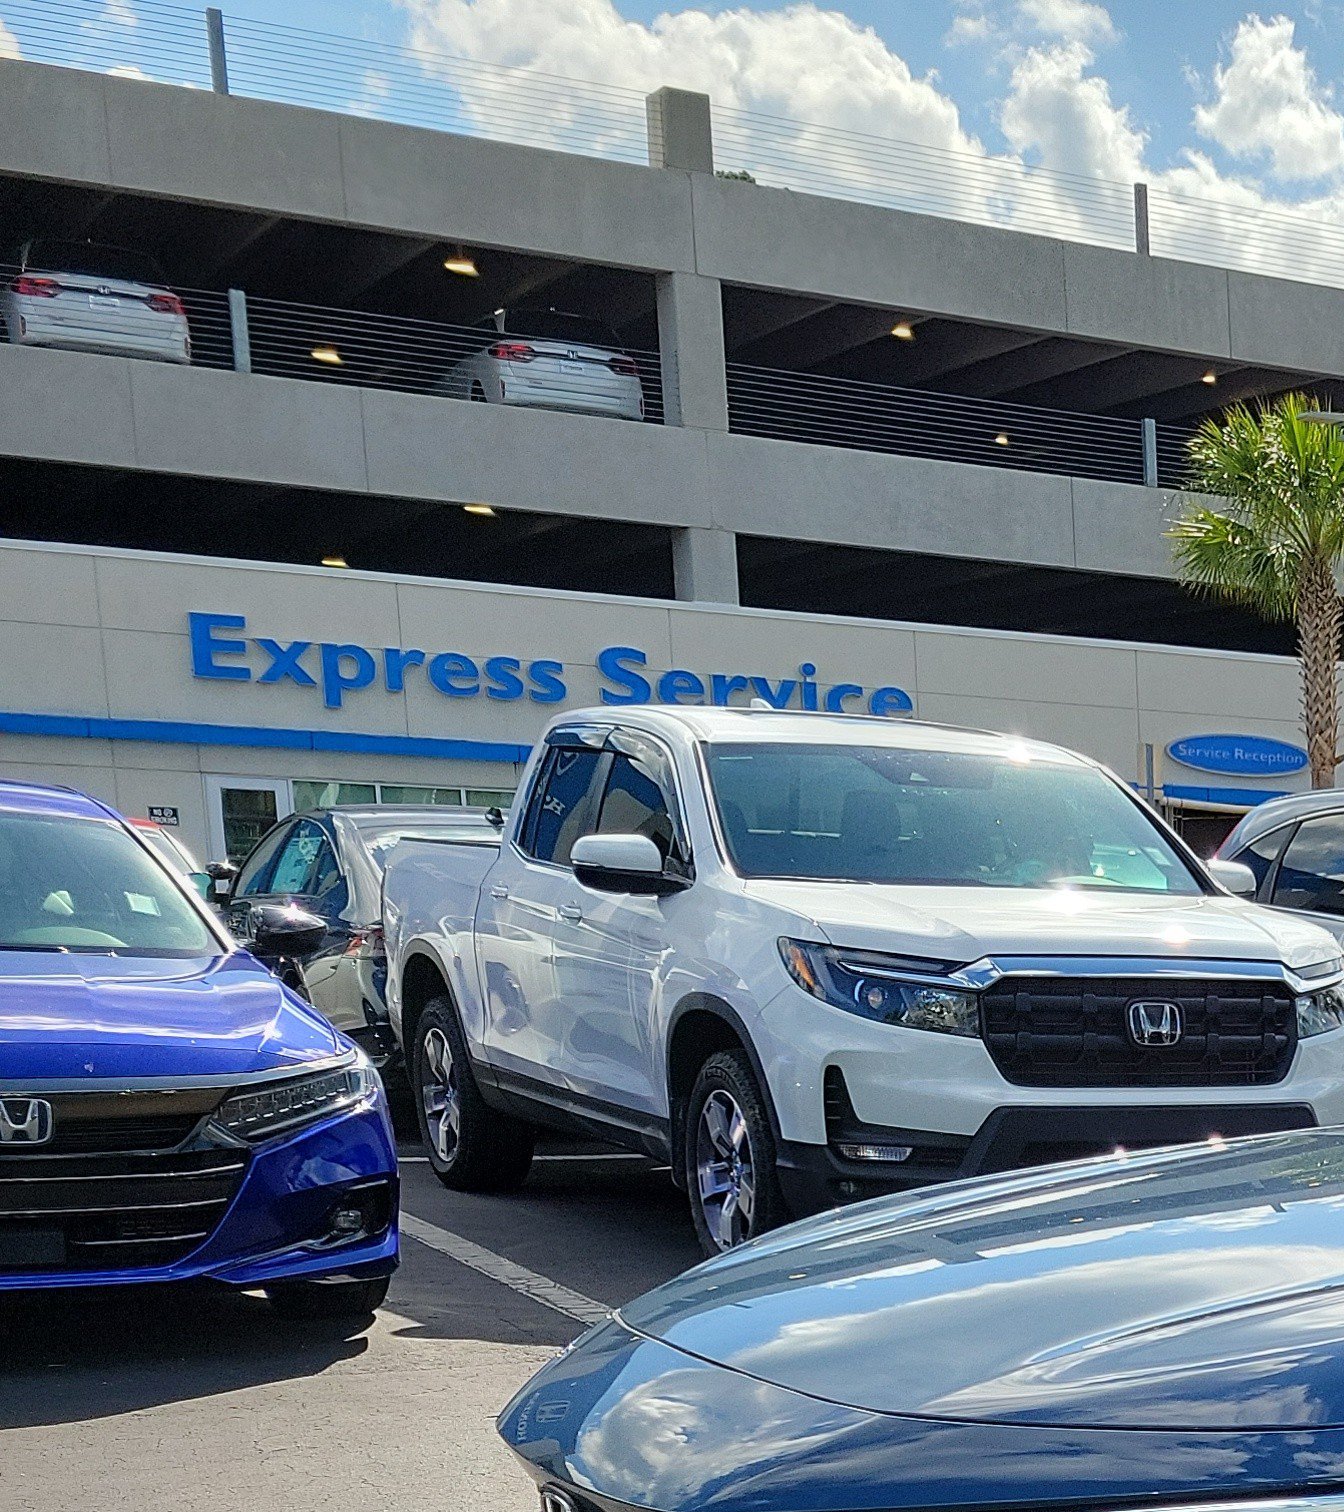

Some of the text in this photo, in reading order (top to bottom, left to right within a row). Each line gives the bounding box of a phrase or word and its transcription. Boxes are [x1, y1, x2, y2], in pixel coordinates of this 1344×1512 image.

[189, 611, 914, 717] Express Service
[1178, 743, 1303, 766] Service Reception
